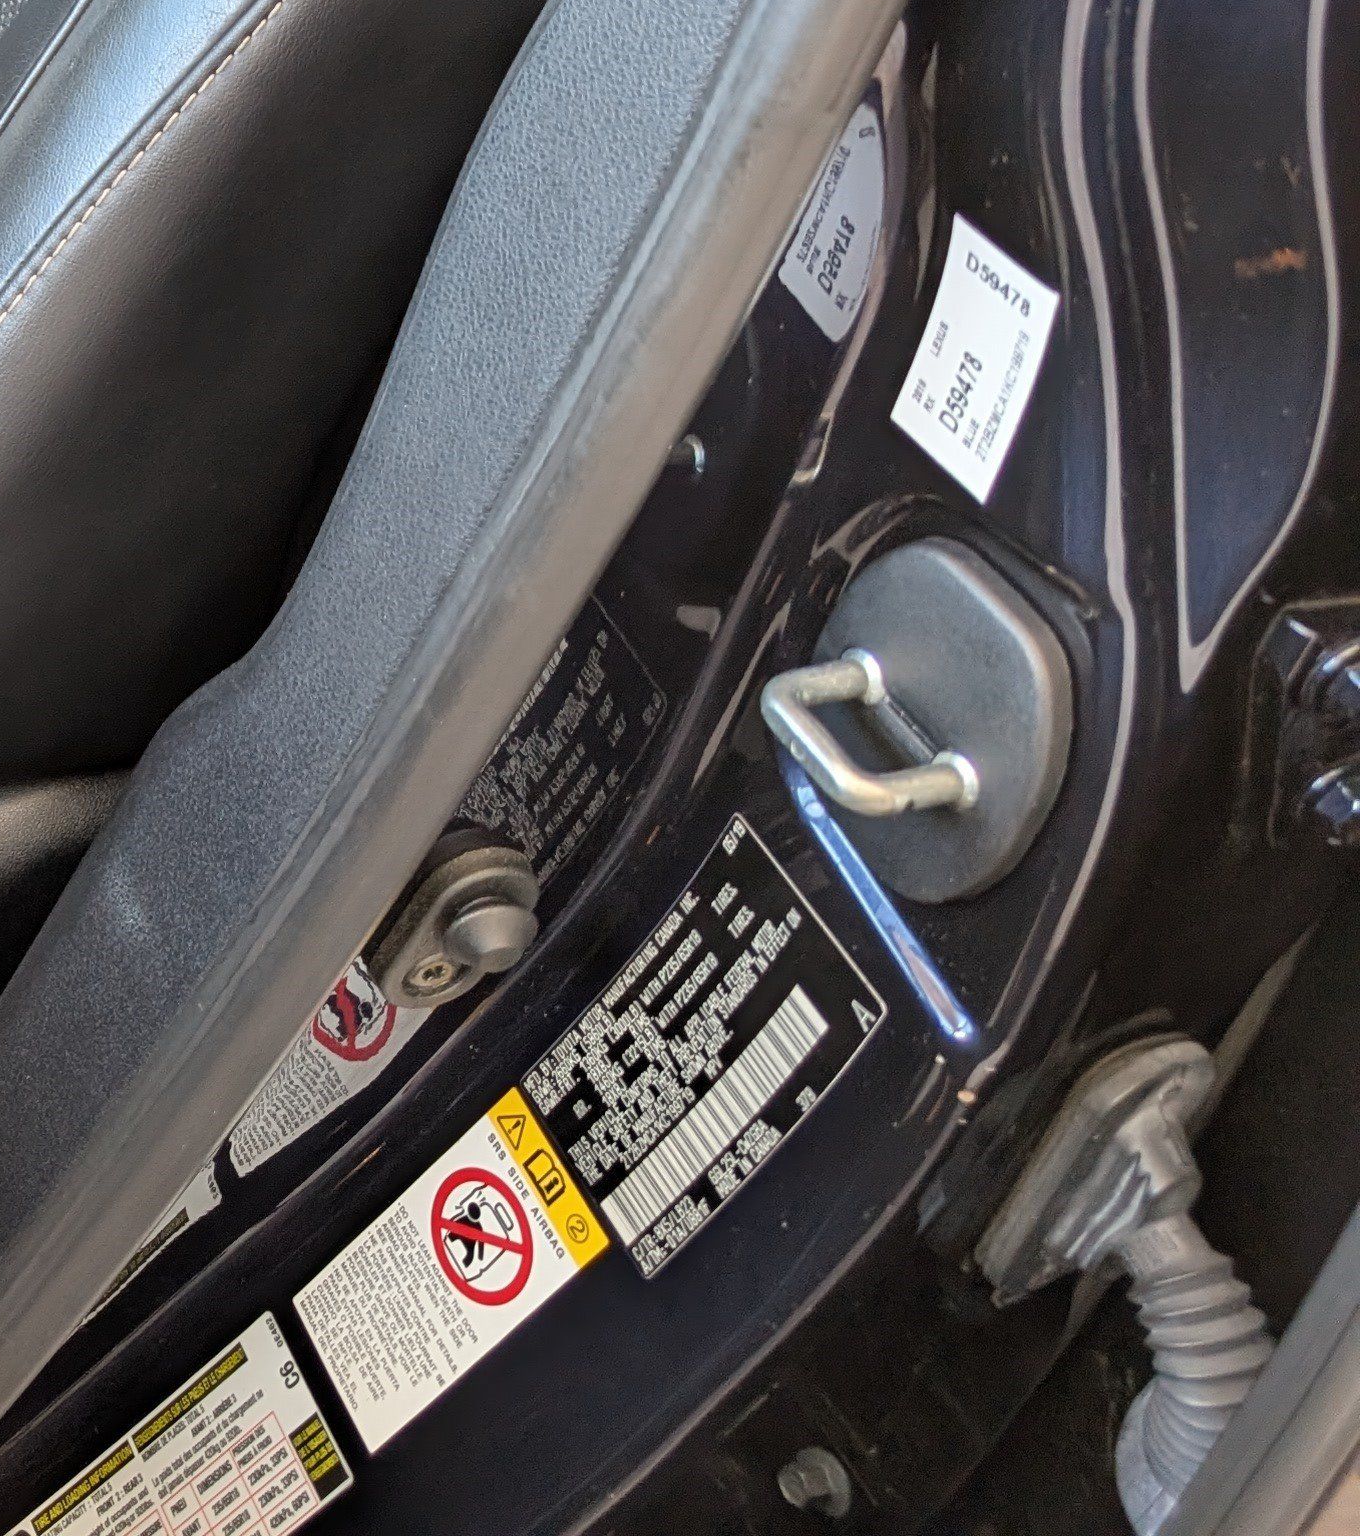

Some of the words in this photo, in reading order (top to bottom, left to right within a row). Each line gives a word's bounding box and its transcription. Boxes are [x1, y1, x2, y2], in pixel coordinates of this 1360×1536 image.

[966, 251, 1031, 317] D59478
[930, 321, 950, 357] LEXUS
[939, 351, 983, 433] D59478
[577, 1000, 606, 1036] MOTOR
[600, 939, 659, 1010] MANUFACTURING
[652, 907, 684, 949] CANADA
[678, 885, 701, 916] INC.
[720, 817, 747, 856] 05/19
[566, 1133, 591, 1163] THIS
[587, 1101, 623, 1142] VEHICLE
[619, 1061, 659, 1109] CONFORMS
[654, 1047, 672, 1069] TO
[665, 1032, 685, 1057] ALL
[681, 981, 729, 1039] APPLICABLE
[721, 946, 756, 990] FEDERAL
[749, 917, 777, 955] MOTOR
[573, 1133, 610, 1176] VEHICLE
[607, 1103, 640, 1142] SAFETY
[634, 1086, 656, 1113] AND
[651, 1059, 680, 1095] THEFT
[673, 1010, 723, 1070] PREVENTION
[715, 965, 760, 1021] STANDARDS
[751, 950, 770, 975] IN
[761, 919, 793, 963] EFFECT
[784, 905, 803, 931] ON
[577, 1036, 610, 1075] 1360KG
[604, 997, 644, 1045] (3000LB)
[637, 974, 664, 1007] WITH
[656, 925, 704, 986] P235/65R18
[578, 1008, 616, 1054] (5860LB)
[592, 1059, 625, 1099] 1460KG
[620, 1021, 660, 1069] (3215LB)
[653, 998, 680, 1031] WITH
[671, 949, 720, 1010] P235/65R18
[845, 993, 878, 1034] A
[585, 1053, 613, 1086] 18X8J
[599, 1075, 629, 1110] 18X8J
[702, 1052, 725, 1081] MPV
[581, 1161, 604, 1188] THE
[598, 1140, 623, 1171] DATE
[618, 1128, 635, 1150] OF
[630, 1076, 684, 1137] MANUFACTURE
[678, 1050, 708, 1085] SHOWN
[486, 1130, 508, 1162] SRS
[506, 1164, 531, 1201] SIDE
[529, 1204, 566, 1260] AIRBAG
[713, 1166, 741, 1200] MADE
[735, 1153, 754, 1177] IN
[747, 1122, 783, 1164] CANADA
[380, 1221, 400, 1253] AIRBAG
[391, 1210, 402, 1225] TO
[399, 1223, 417, 1251] AVOID
[413, 1249, 441, 1295] POTENTIAL
[438, 1293, 458, 1324] DEATH
[454, 1322, 466, 1339] OR
[397, 1204, 409, 1220] DO
[406, 1218, 419, 1238] NOT
[416, 1238, 433, 1262] LEAN
[429, 1261, 453, 1298] AGAINST
[450, 1297, 463, 1317] THE
[460, 1316, 479, 1344] DOOR
[374, 1226, 387, 1246] SEE
[405, 1282, 427, 1318] MANUAL
[424, 1317, 438, 1338] FOR
[386, 1215, 409, 1252] SERIOUS
[406, 1251, 426, 1282] INJURY
[422, 1281, 441, 1309] WHEN
[437, 1308, 451, 1327] THE
[447, 1326, 463, 1349] SIDE
[277, 1357, 302, 1391] C6
[33, 1511, 52, 1533] TIRE
[46, 1500, 65, 1522] AND
[60, 1478, 91, 1510] LOADING
[86, 1442, 132, 1487] INFORMATION
[90, 1483, 109, 1504] TOTAL
[94, 1494, 116, 1518] FRONT
[113, 1489, 122, 1502] 2
[121, 1474, 140, 1495] REAR
[135, 1470, 144, 1483] 3
